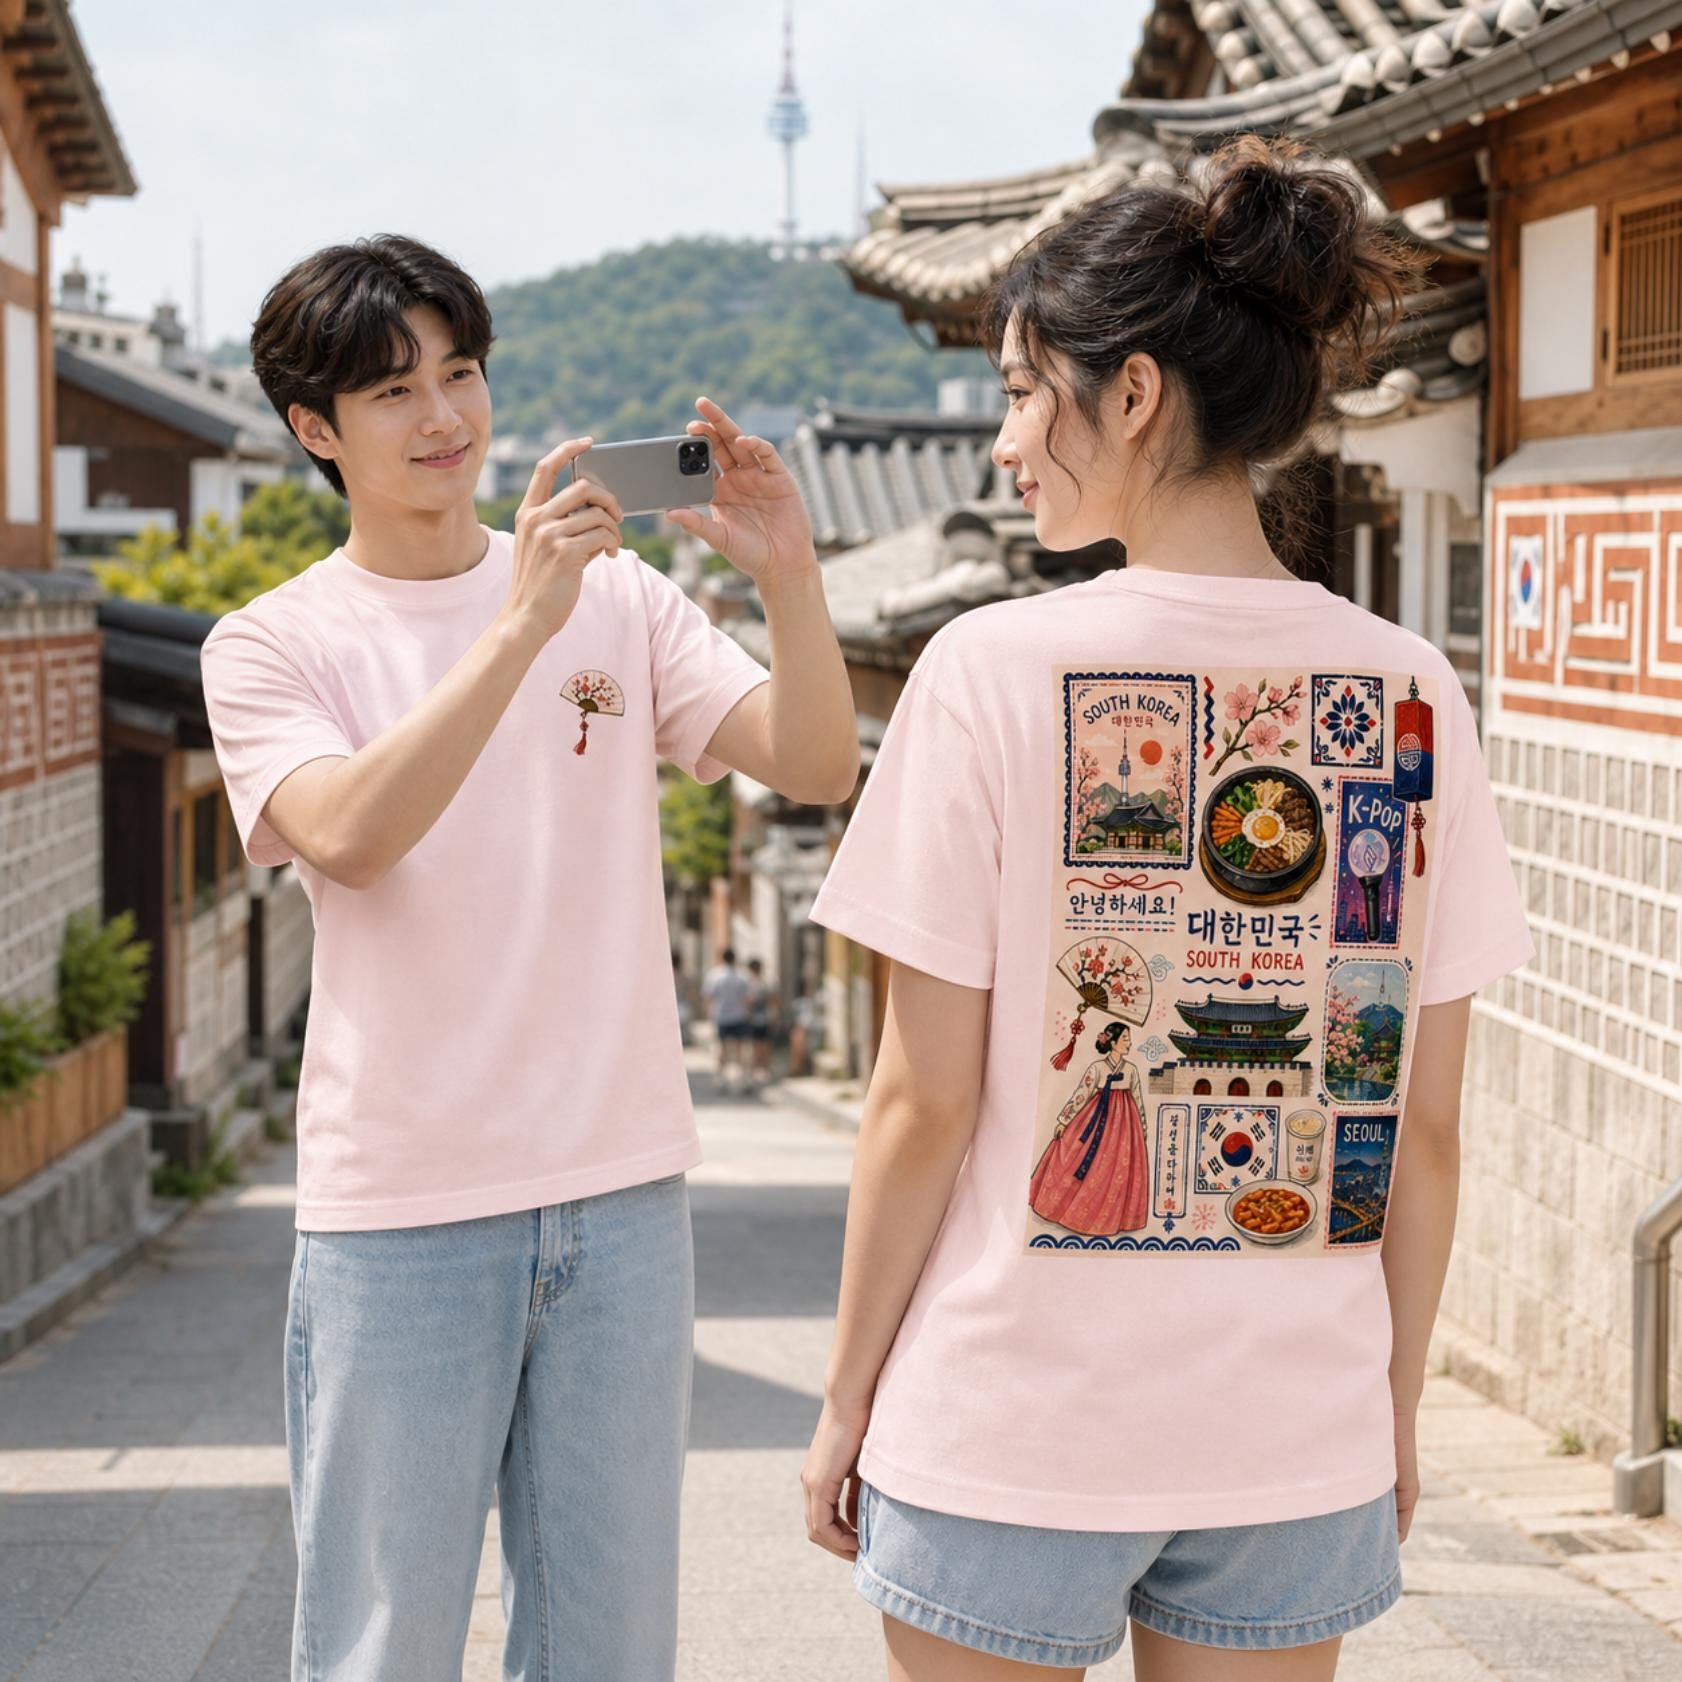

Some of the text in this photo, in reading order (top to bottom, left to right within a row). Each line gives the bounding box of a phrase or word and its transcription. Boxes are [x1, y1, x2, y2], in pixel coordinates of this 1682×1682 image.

[1083, 694, 1180, 727] SOUTH KOREA
[1348, 794, 1402, 832] K-POP
[1069, 892, 1175, 916] 안녕하세요!
[1187, 908, 1305, 948] 대한민국
[1186, 951, 1304, 971] SOUTH KOREA
[1344, 1123, 1384, 1142] SEOUL
